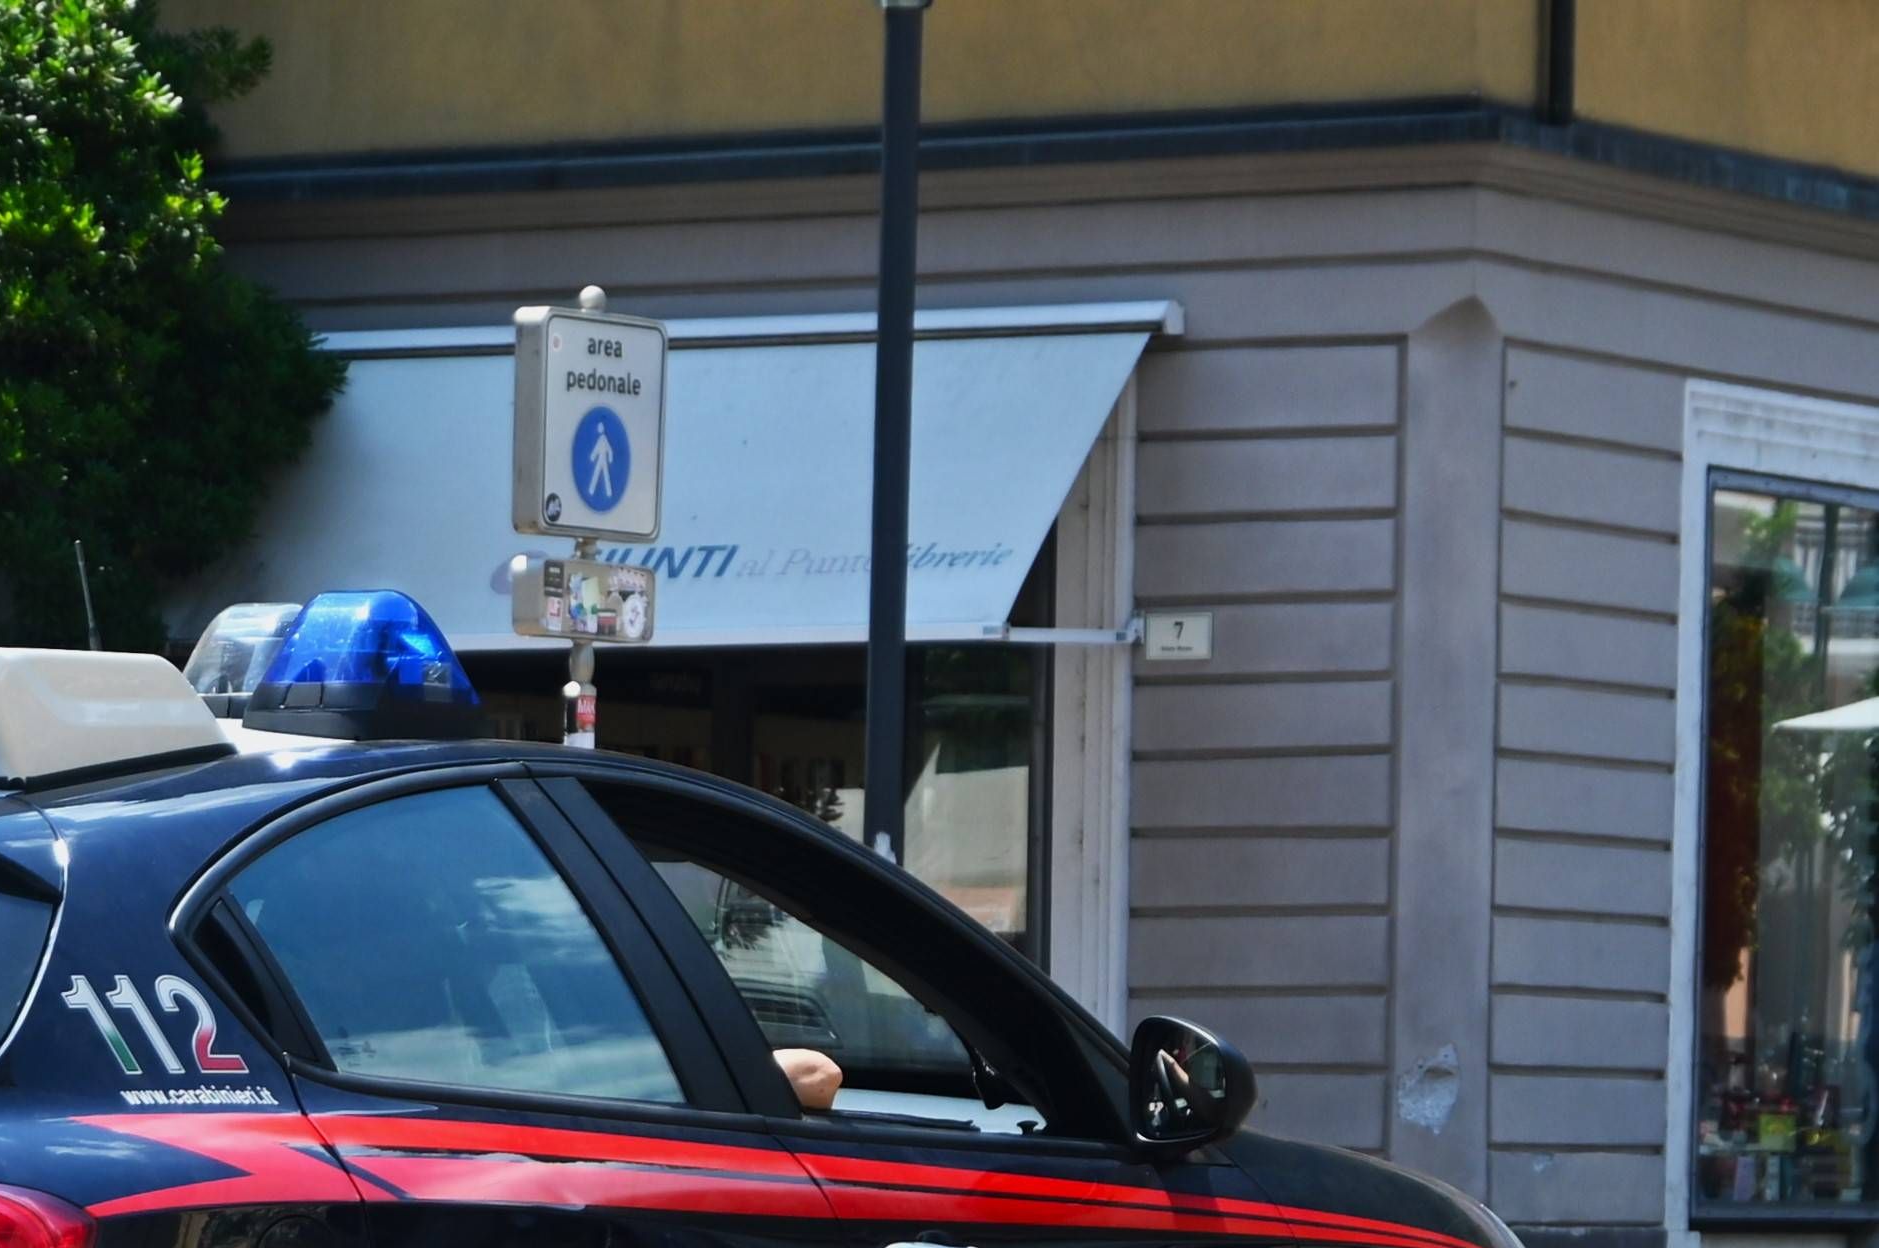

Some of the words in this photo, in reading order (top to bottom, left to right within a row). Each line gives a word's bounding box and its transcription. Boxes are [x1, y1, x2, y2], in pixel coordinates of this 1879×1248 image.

[588, 337, 623, 358] area
[566, 368, 642, 396] pedonale
[736, 548, 775, 576] al
[907, 542, 1013, 569] ibrerie
[1173, 621, 1185, 640] 7
[60, 974, 250, 1075] 112
[120, 1085, 279, 1105] www.carabinieri.it
